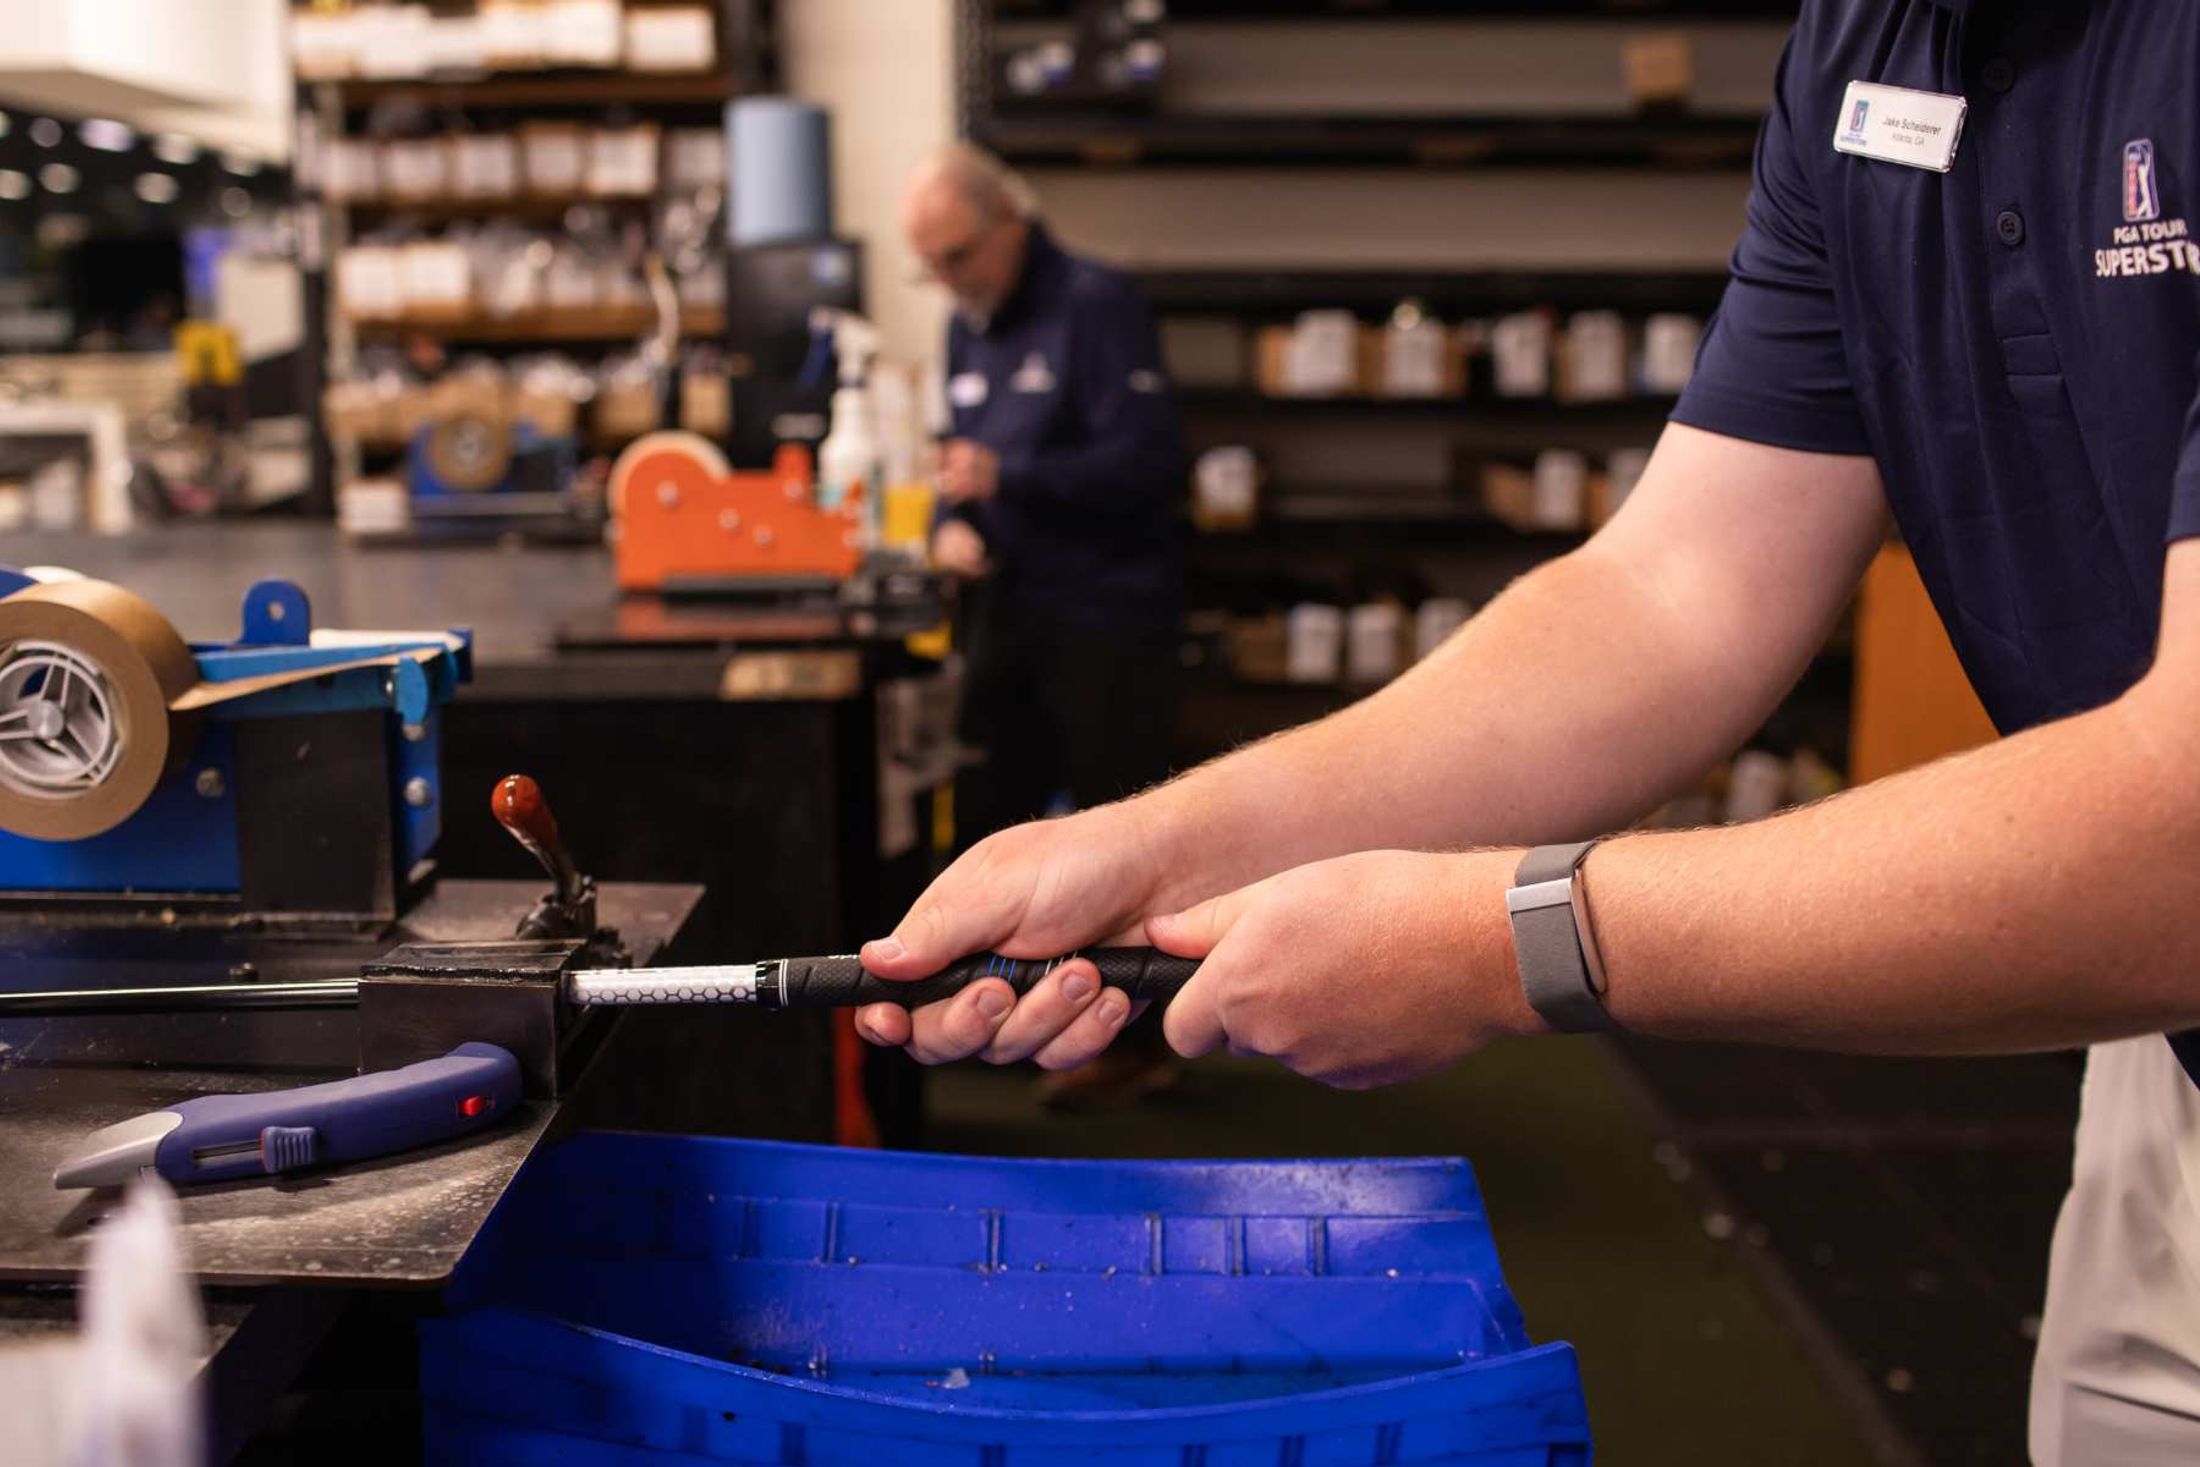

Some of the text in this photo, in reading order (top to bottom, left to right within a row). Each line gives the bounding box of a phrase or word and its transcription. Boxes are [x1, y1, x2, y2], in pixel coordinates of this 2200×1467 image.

[1882, 115, 1900, 128] Jake
[2113, 218, 2188, 244] PGA TOUR
